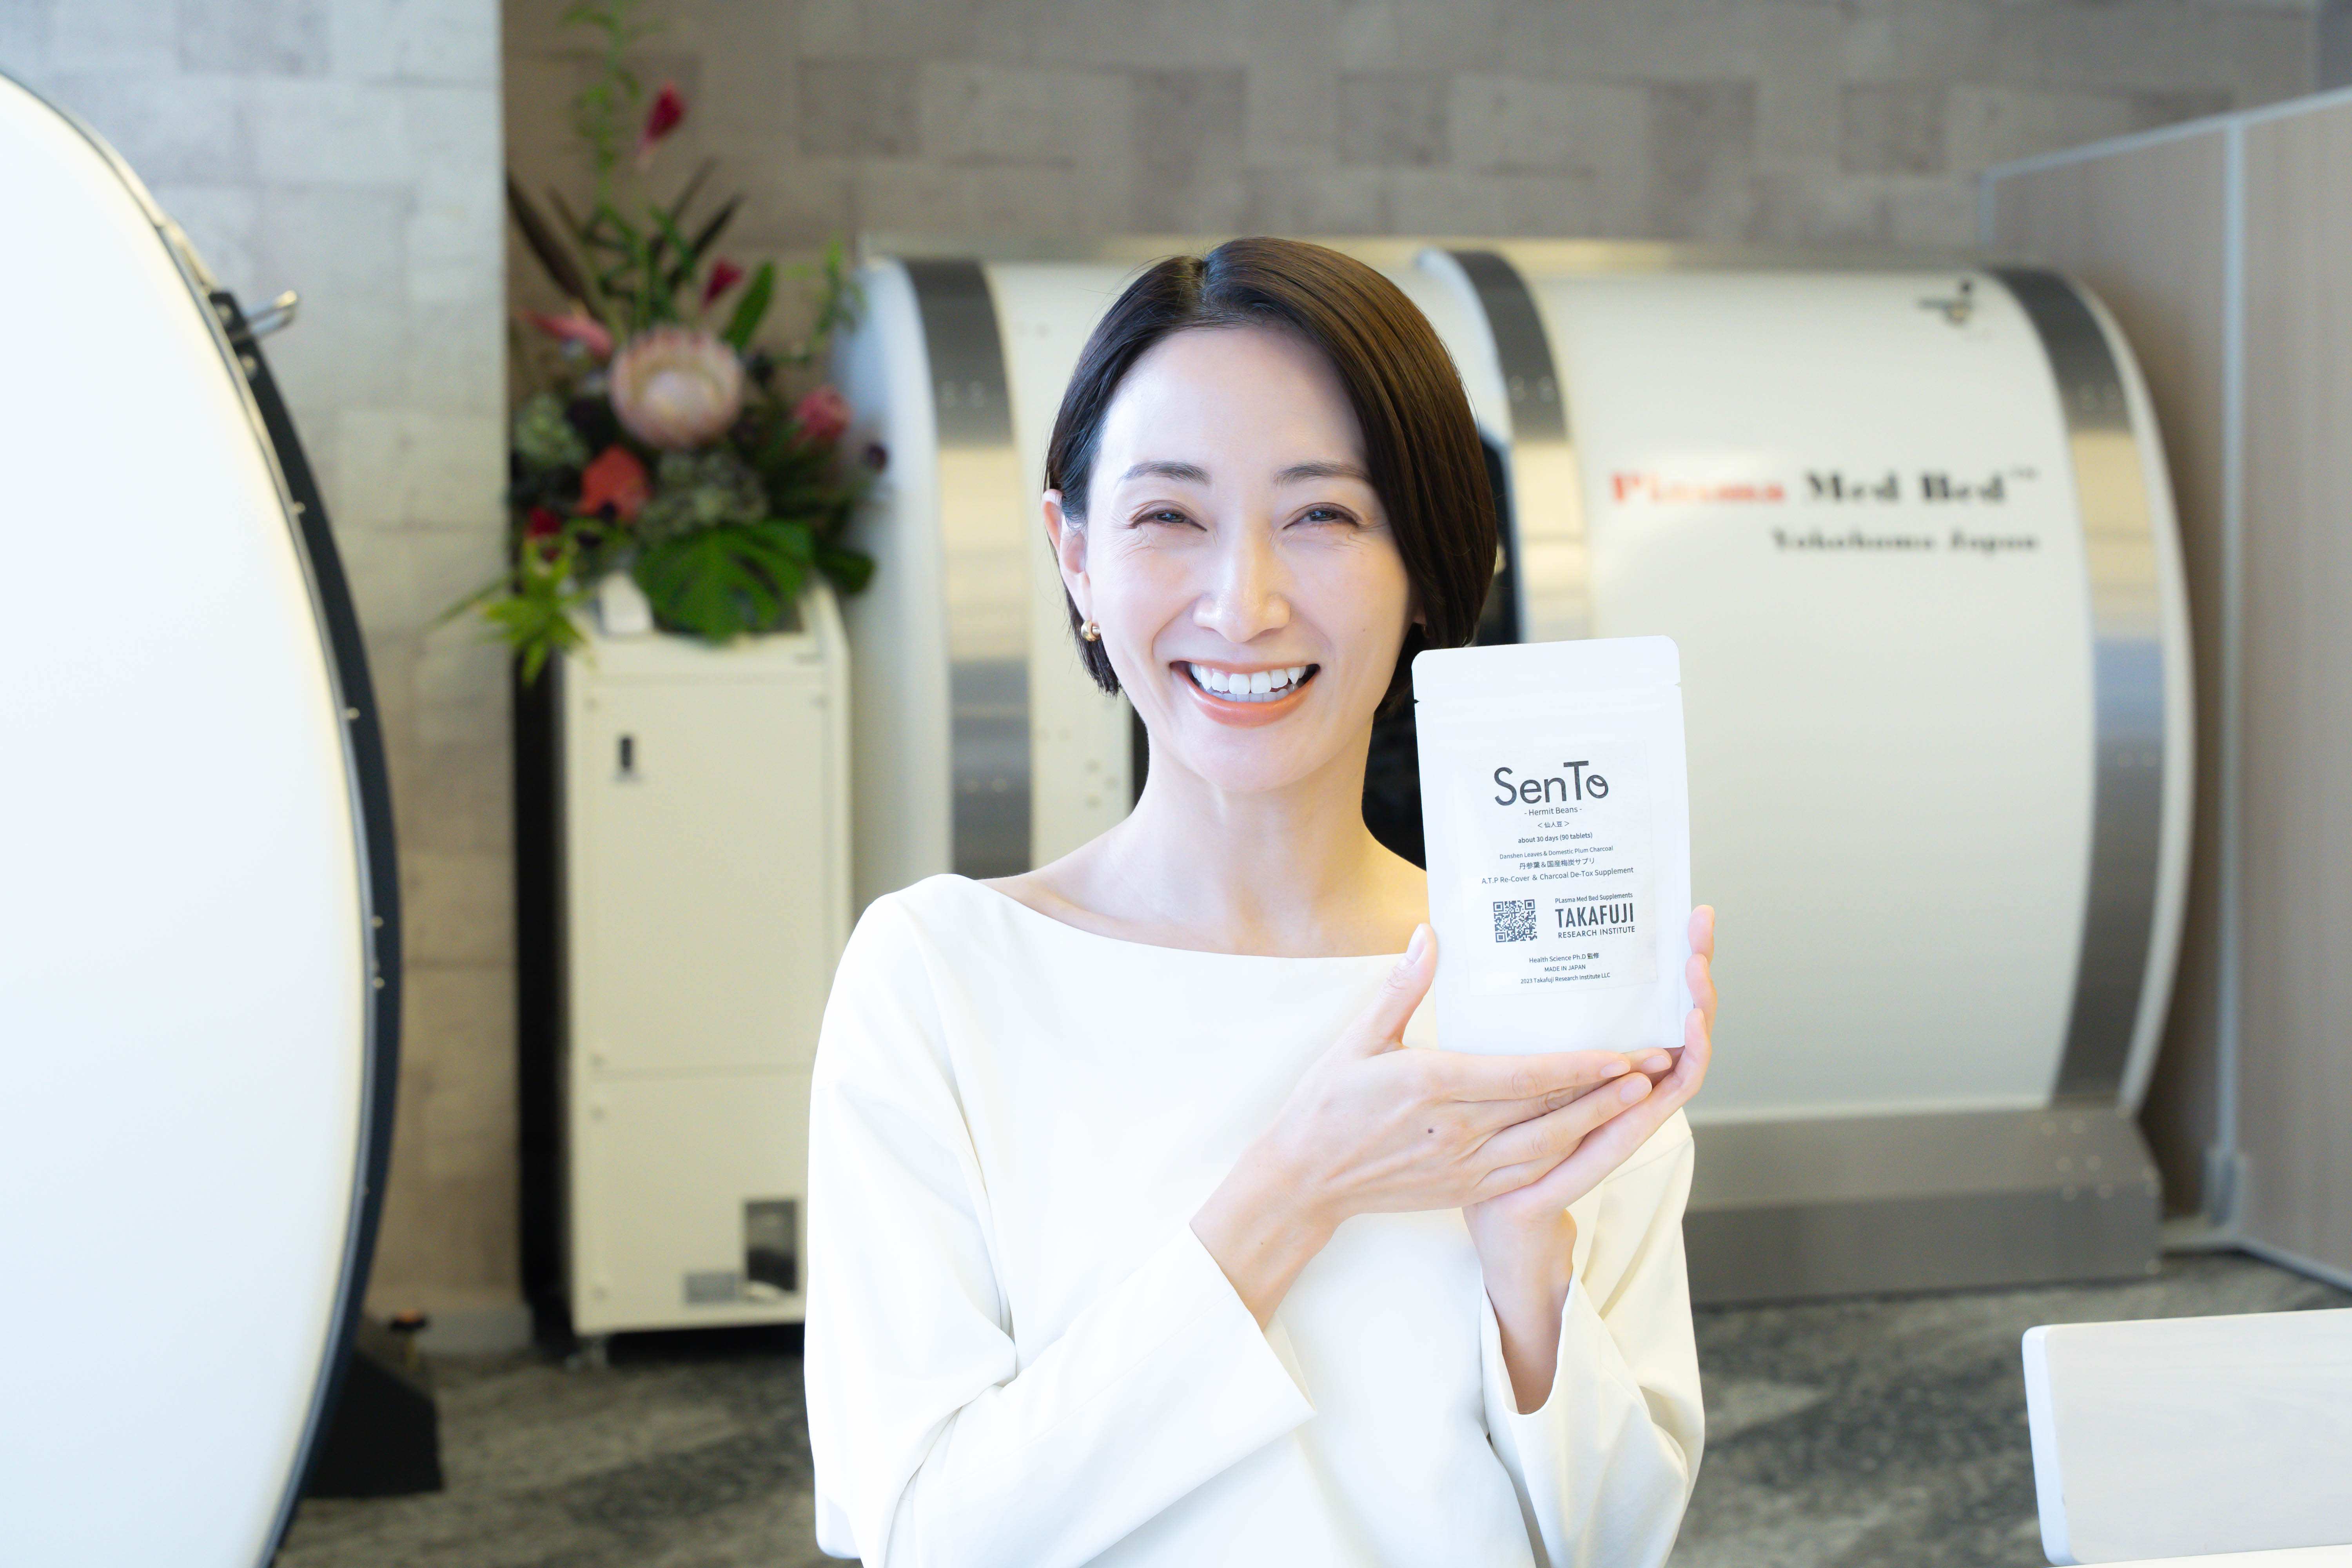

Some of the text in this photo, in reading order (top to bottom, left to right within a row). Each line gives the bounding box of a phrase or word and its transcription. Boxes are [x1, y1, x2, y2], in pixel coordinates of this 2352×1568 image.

[1804, 471, 1901, 503] Med
[1494, 760, 1609, 806] SenTo
[1529, 808, 1554, 816] Hermit
[1540, 871, 1569, 880] Charcoal
[1595, 867, 1634, 877] Supplement
[1599, 892, 1633, 900] Supplements
[1555, 903, 1633, 928] TAKAFUJI
[1558, 926, 1635, 938] RESEARCH INSTITUTE
